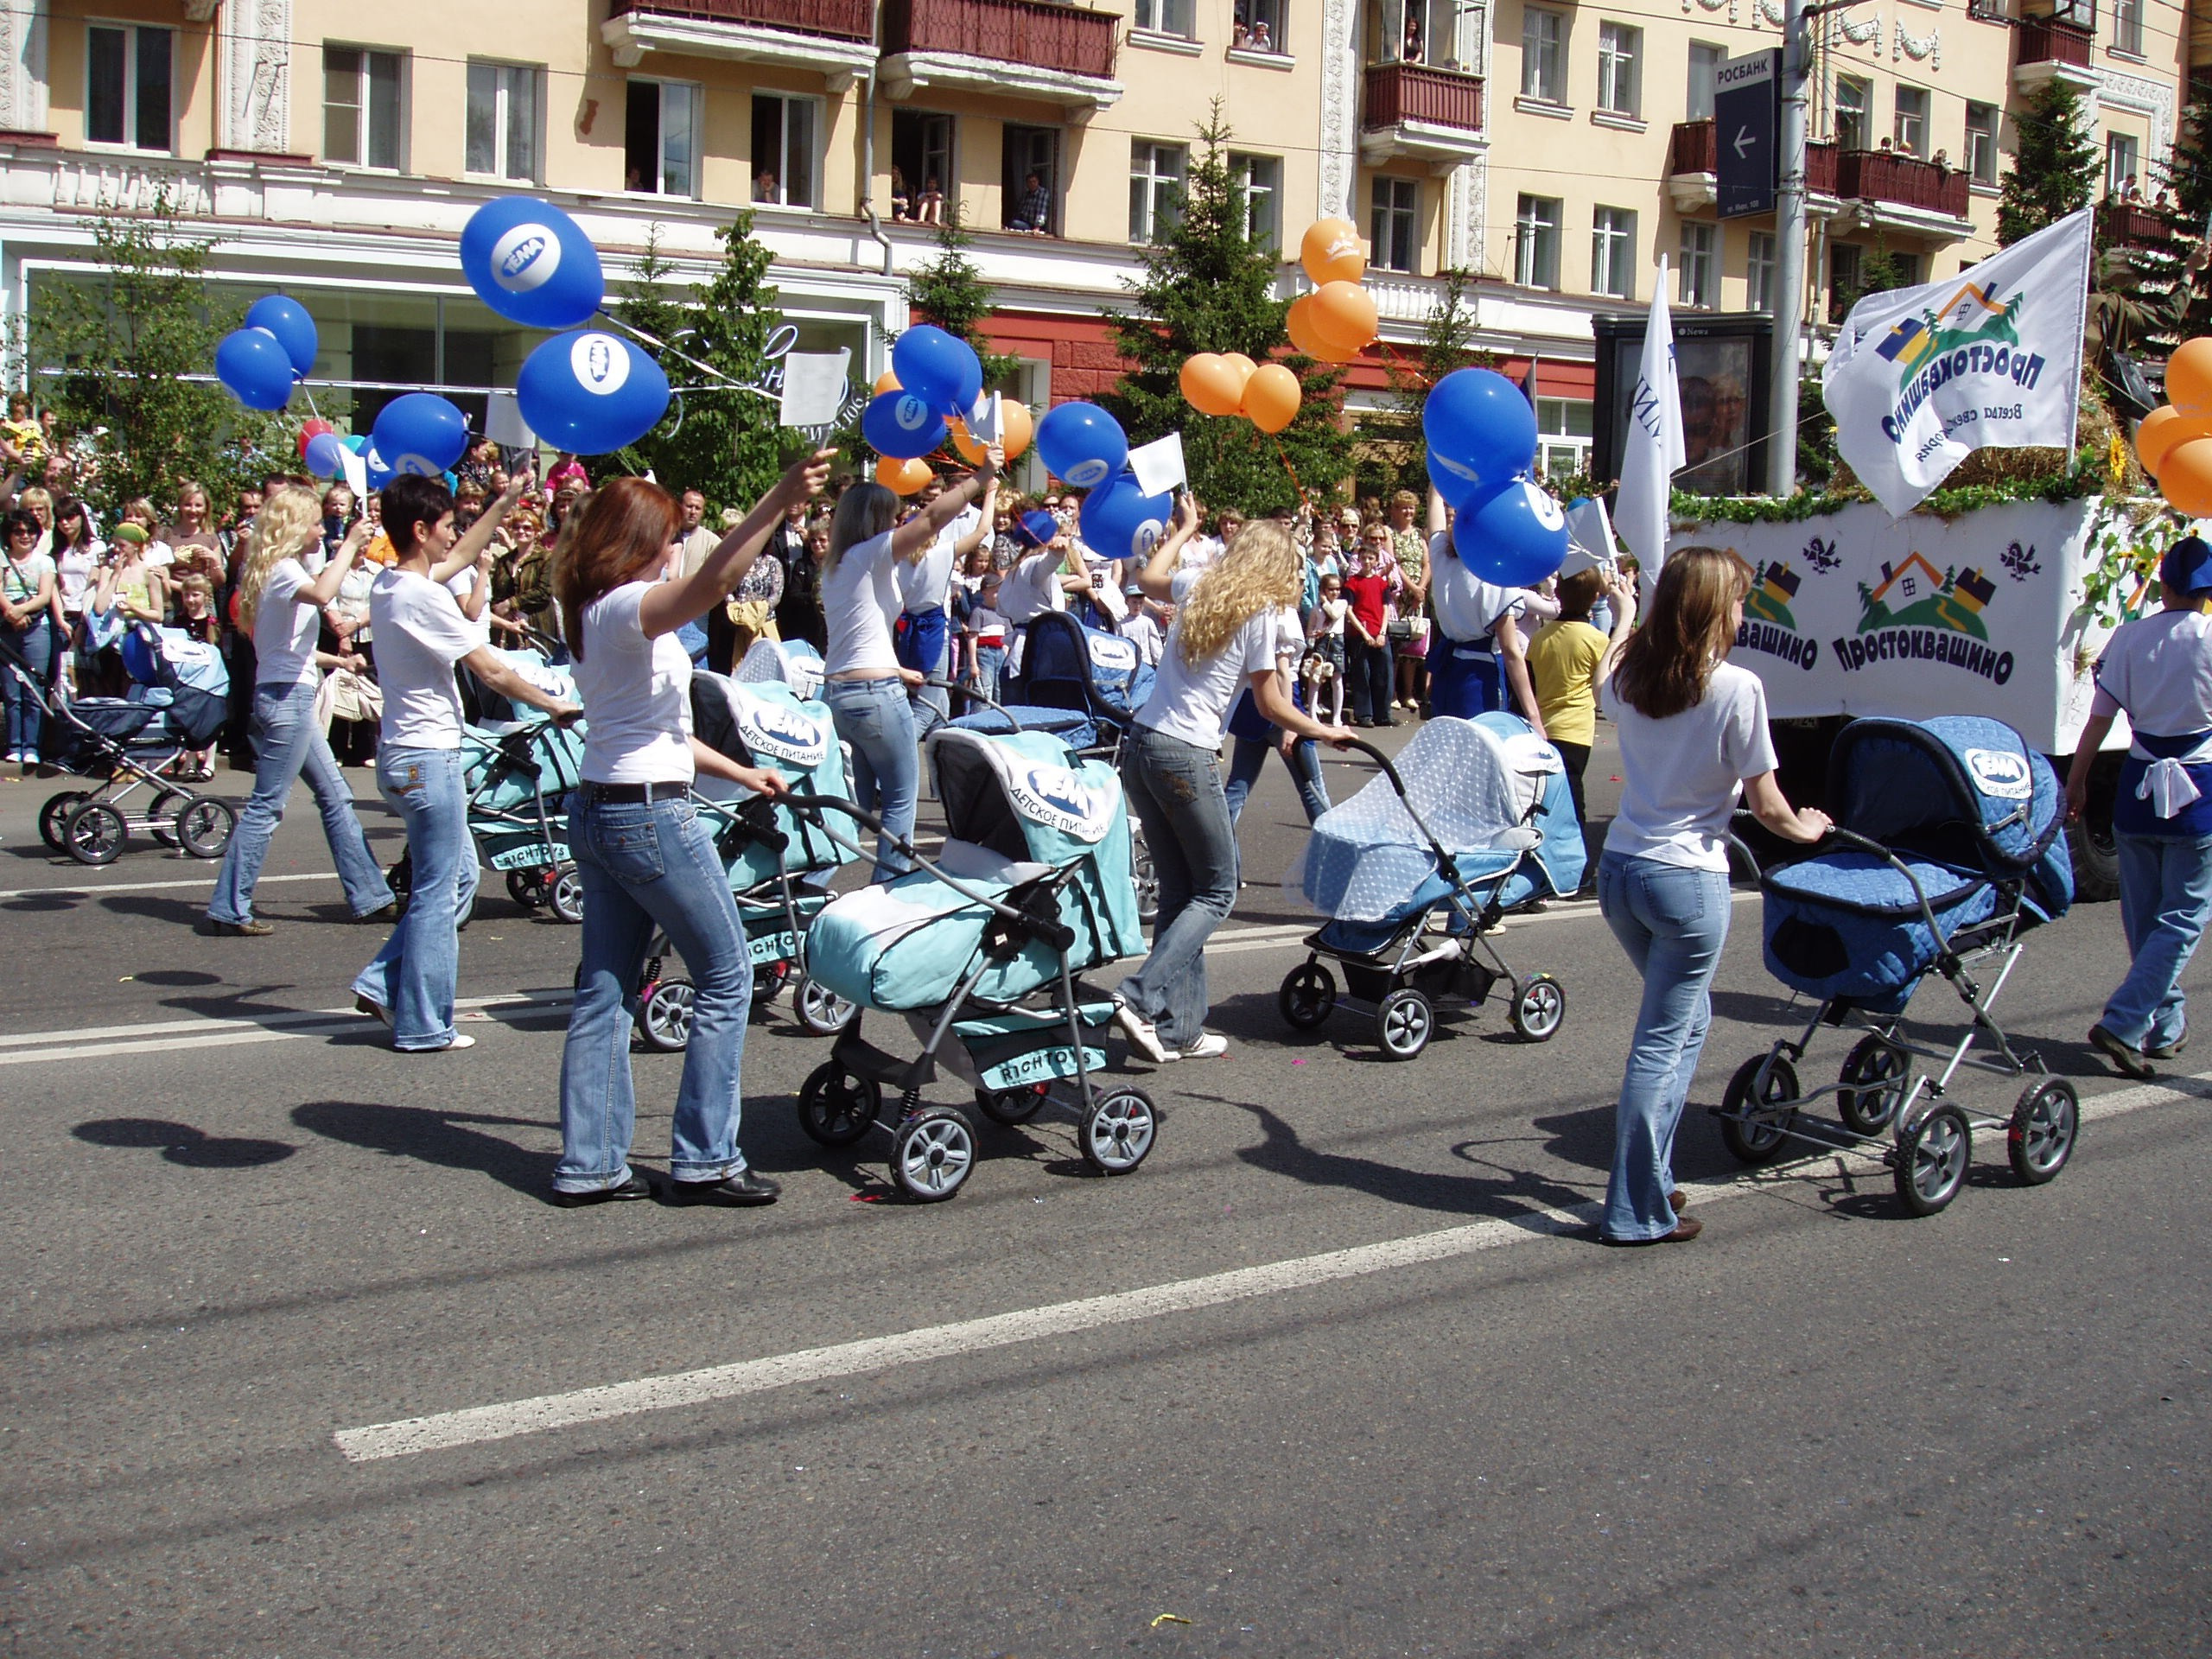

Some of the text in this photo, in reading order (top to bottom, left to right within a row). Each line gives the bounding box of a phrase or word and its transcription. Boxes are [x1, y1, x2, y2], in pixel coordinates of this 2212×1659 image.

[1718, 58, 1768, 84] РОСБАНК
[740, 725, 825, 760] ДЕТСКОЕ ПИТАНИЕ
[1010, 788, 1058, 826] ДЕТСКОЕ
[503, 847, 565, 864] RICHTOS
